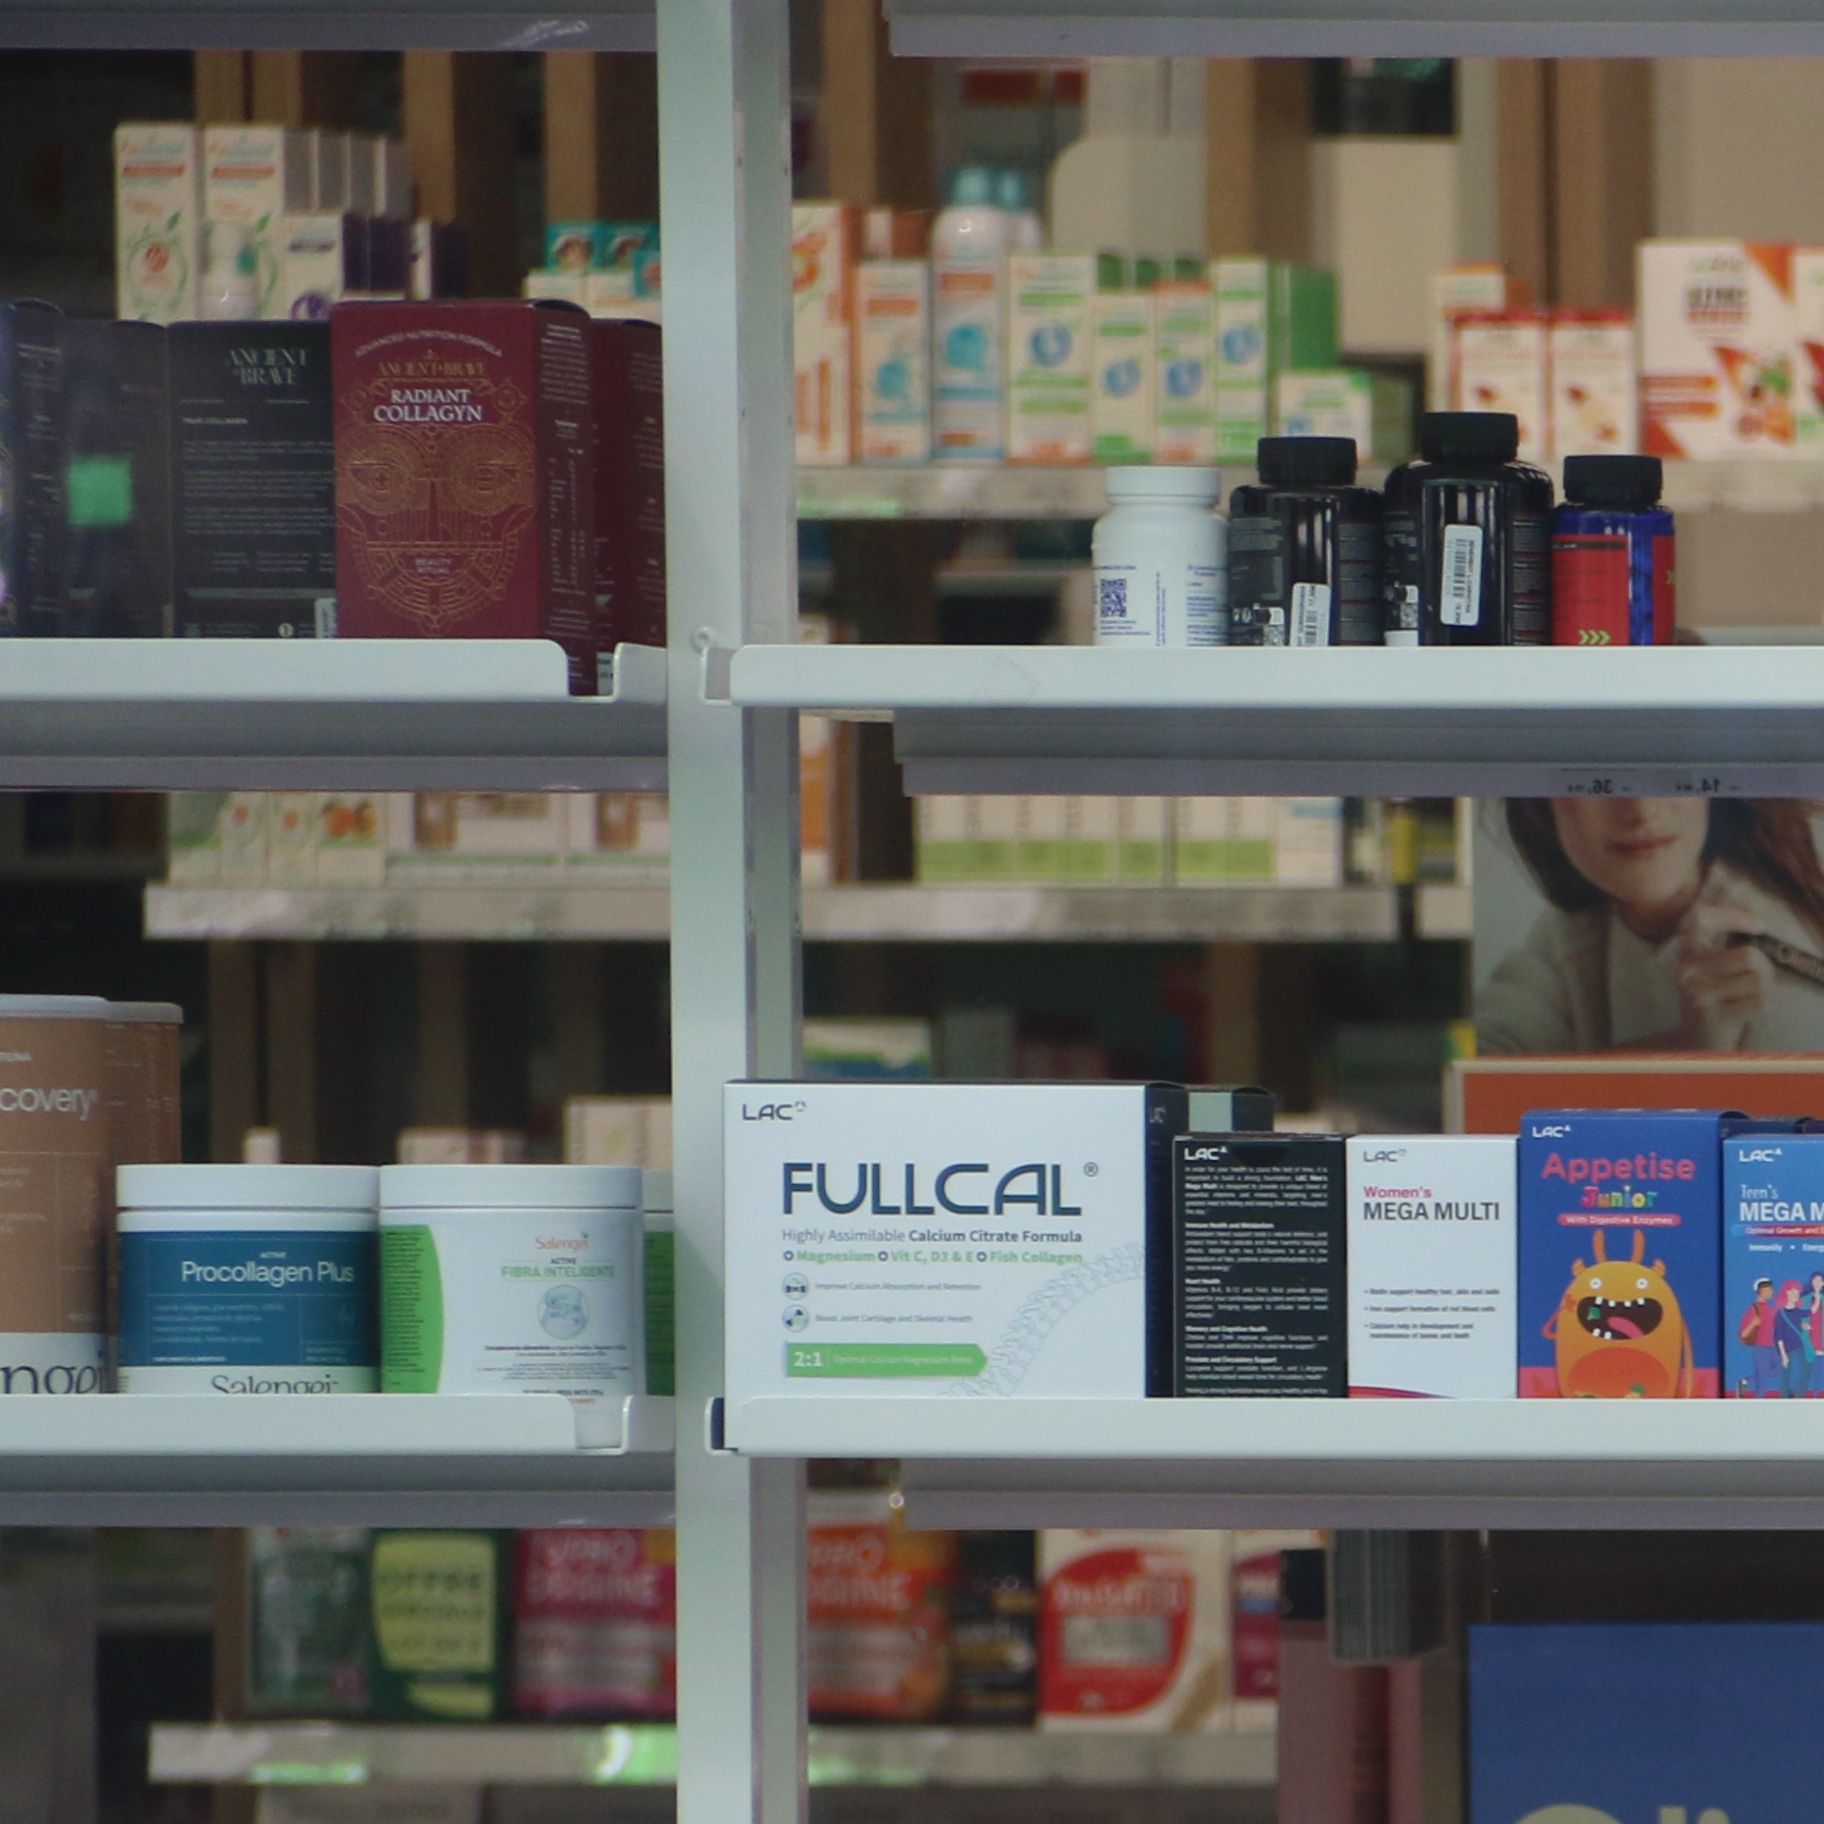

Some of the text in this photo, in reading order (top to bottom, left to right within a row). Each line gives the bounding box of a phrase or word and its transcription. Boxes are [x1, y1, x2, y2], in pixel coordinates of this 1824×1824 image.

[390, 389, 472, 402] RADIANT
[373, 405, 483, 422] COLLAGYN
[1541, 1153, 1697, 1183] Appetise
[782, 1162, 1082, 1216] FULLCAL
[1363, 1186, 1432, 1199] Women's
[1581, 1183, 1658, 1209] Junior
[1363, 1202, 1500, 1222] MEGA MULTI
[1739, 1202, 1806, 1221] MEGA
[782, 1228, 1082, 1243] Highly Assimilable Calcium Citrate Formula
[796, 1249, 1083, 1263] Magnesium Vit D3 Fish Collagen
[181, 1260, 355, 1287] Procollagen Plus
[793, 1352, 824, 1368] 2:1
